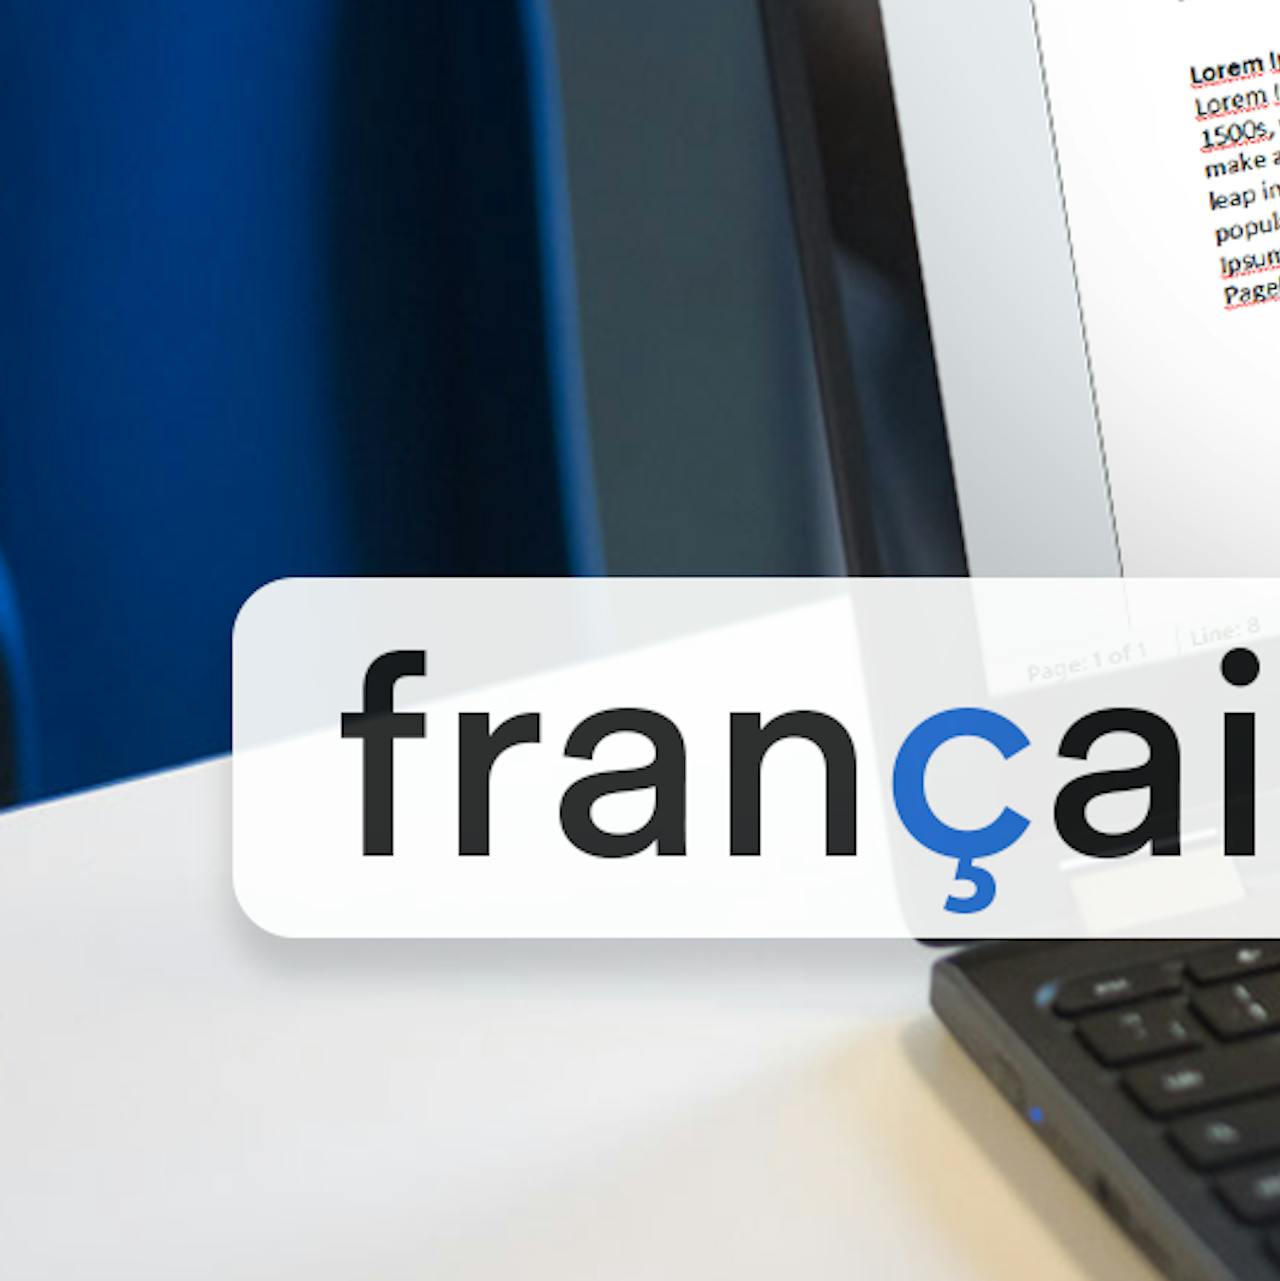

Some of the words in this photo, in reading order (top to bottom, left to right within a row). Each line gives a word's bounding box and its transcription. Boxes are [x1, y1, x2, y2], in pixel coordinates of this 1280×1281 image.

[1189, 56, 1266, 85] Lorem
[1195, 88, 1270, 117] Lorem
[1202, 118, 1276, 151] 1500s,
[1205, 152, 1267, 179] make
[1209, 189, 1256, 211] leap
